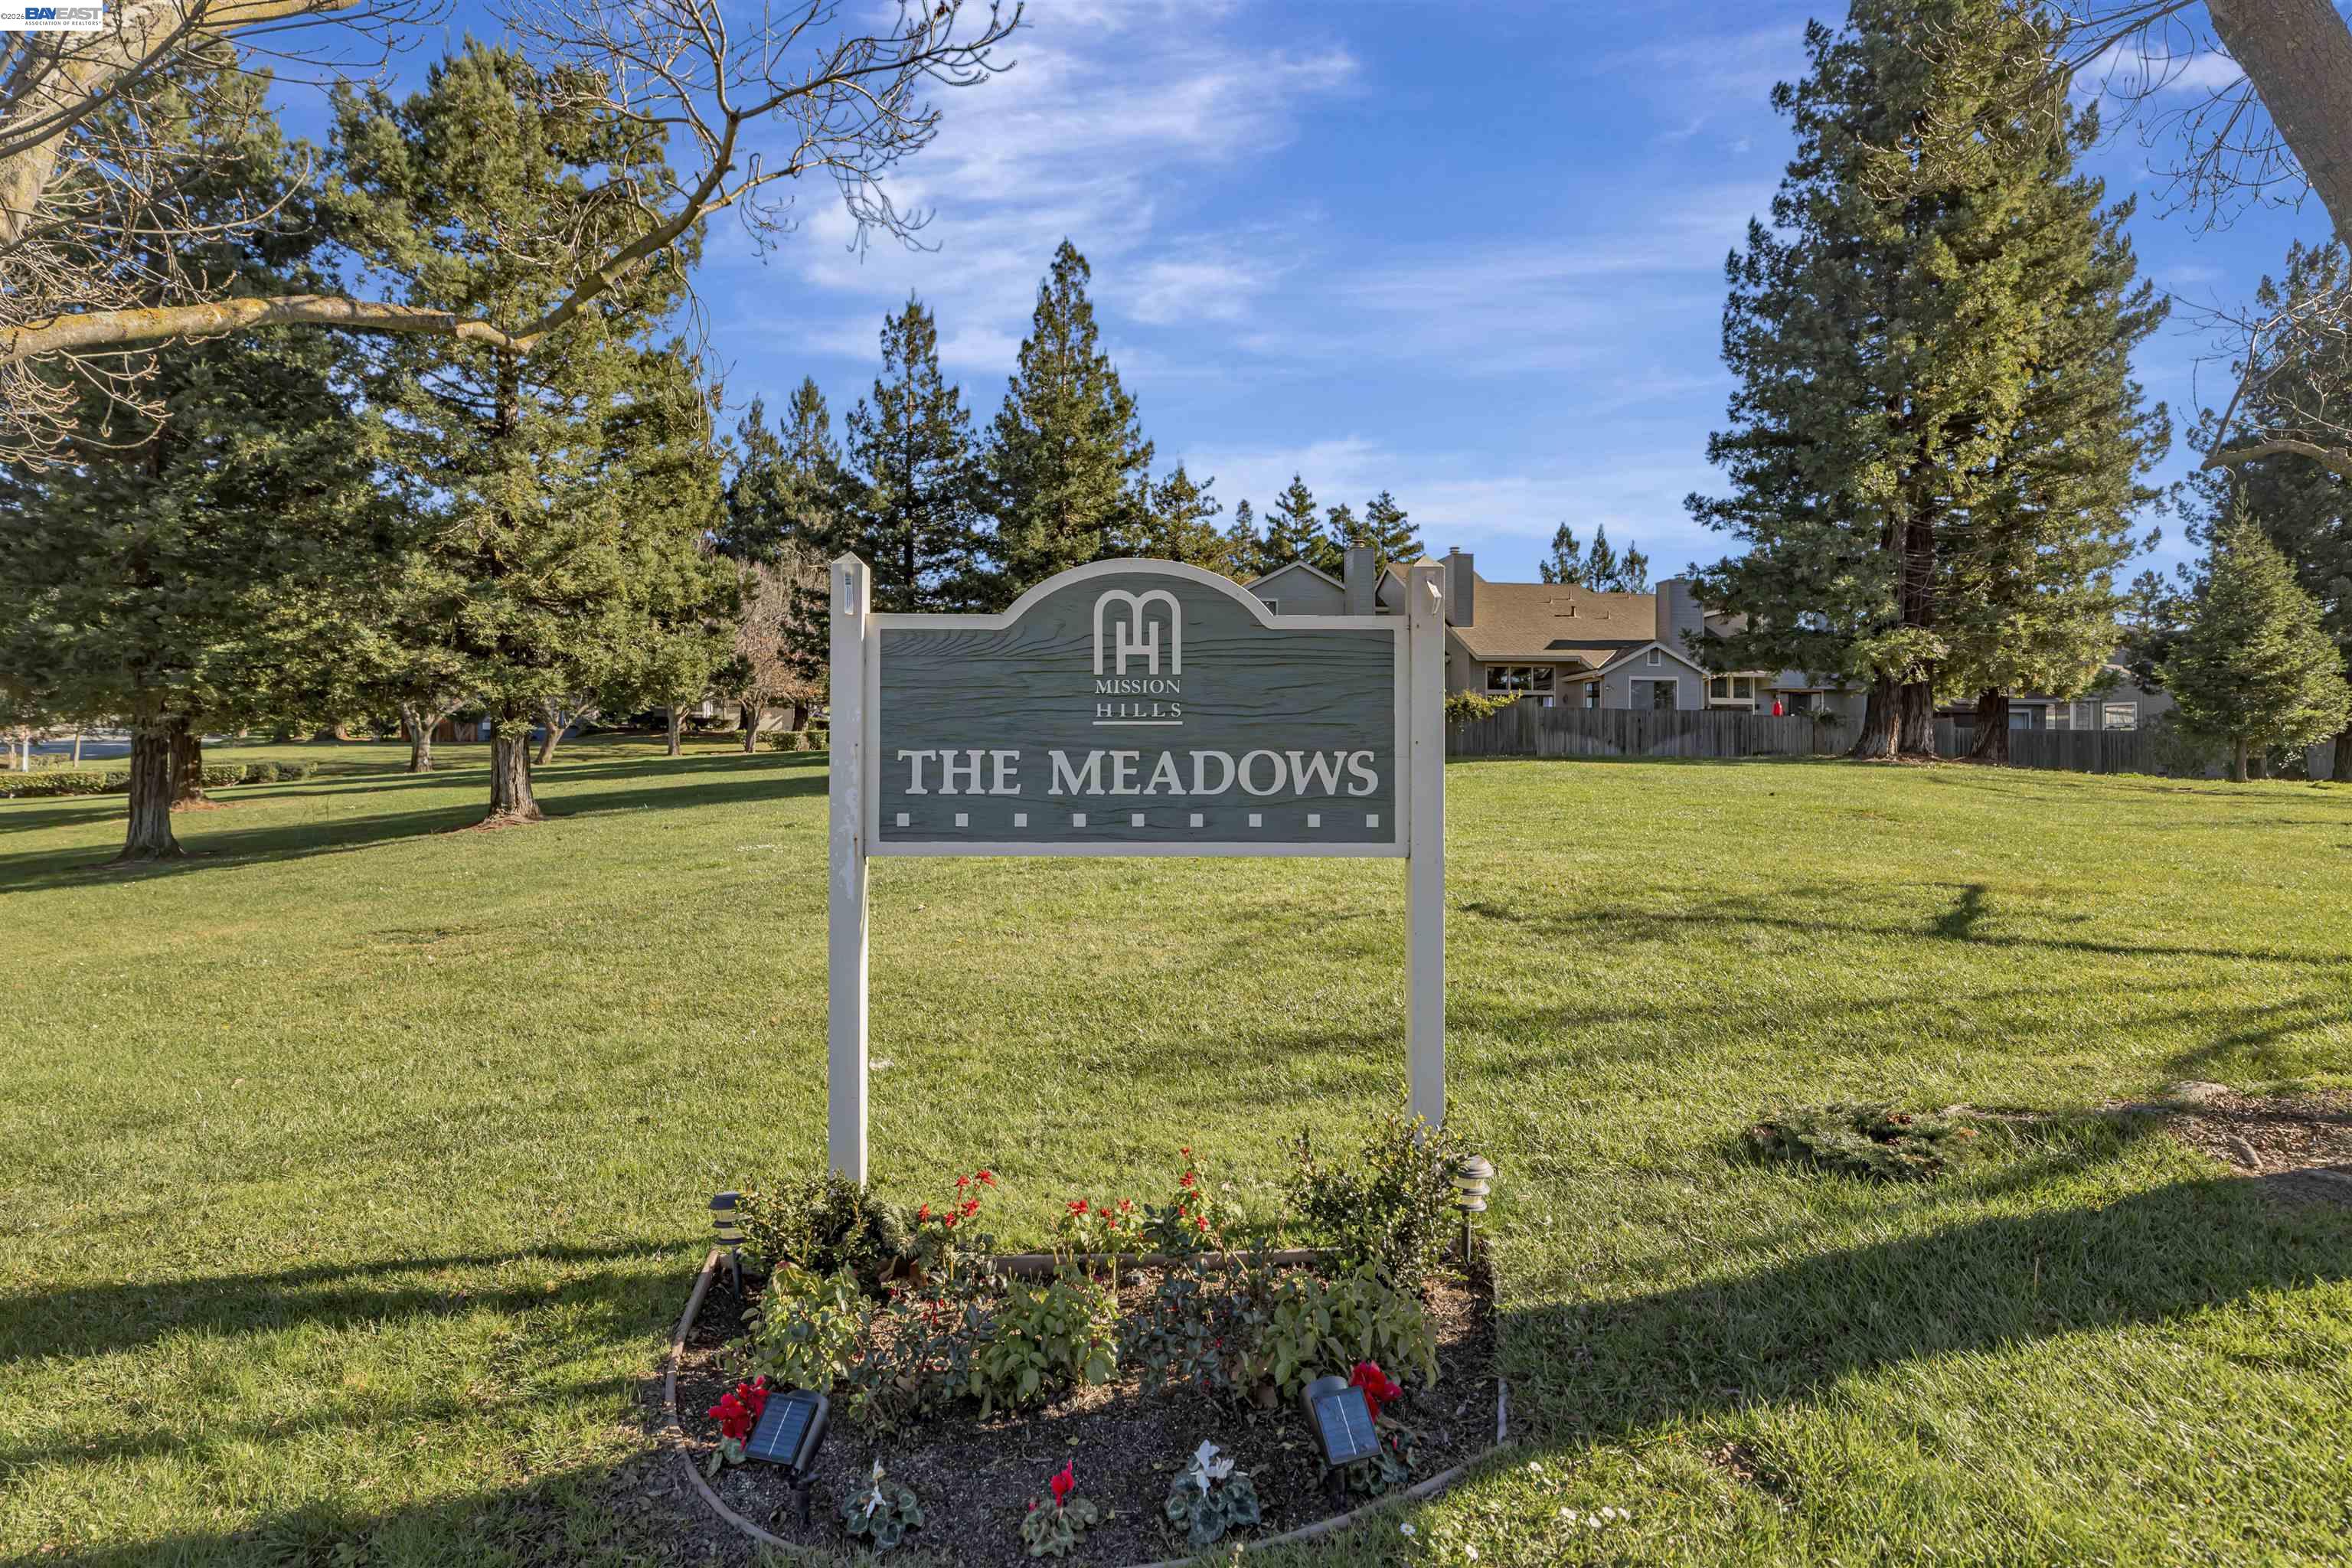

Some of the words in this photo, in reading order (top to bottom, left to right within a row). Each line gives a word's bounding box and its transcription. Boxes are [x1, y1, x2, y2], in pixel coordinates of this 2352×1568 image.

[1095, 680, 1181, 694] MISSION
[1096, 703, 1181, 717] HILLS
[897, 750, 1021, 795] THE
[1048, 750, 1378, 796] MEADOWS
